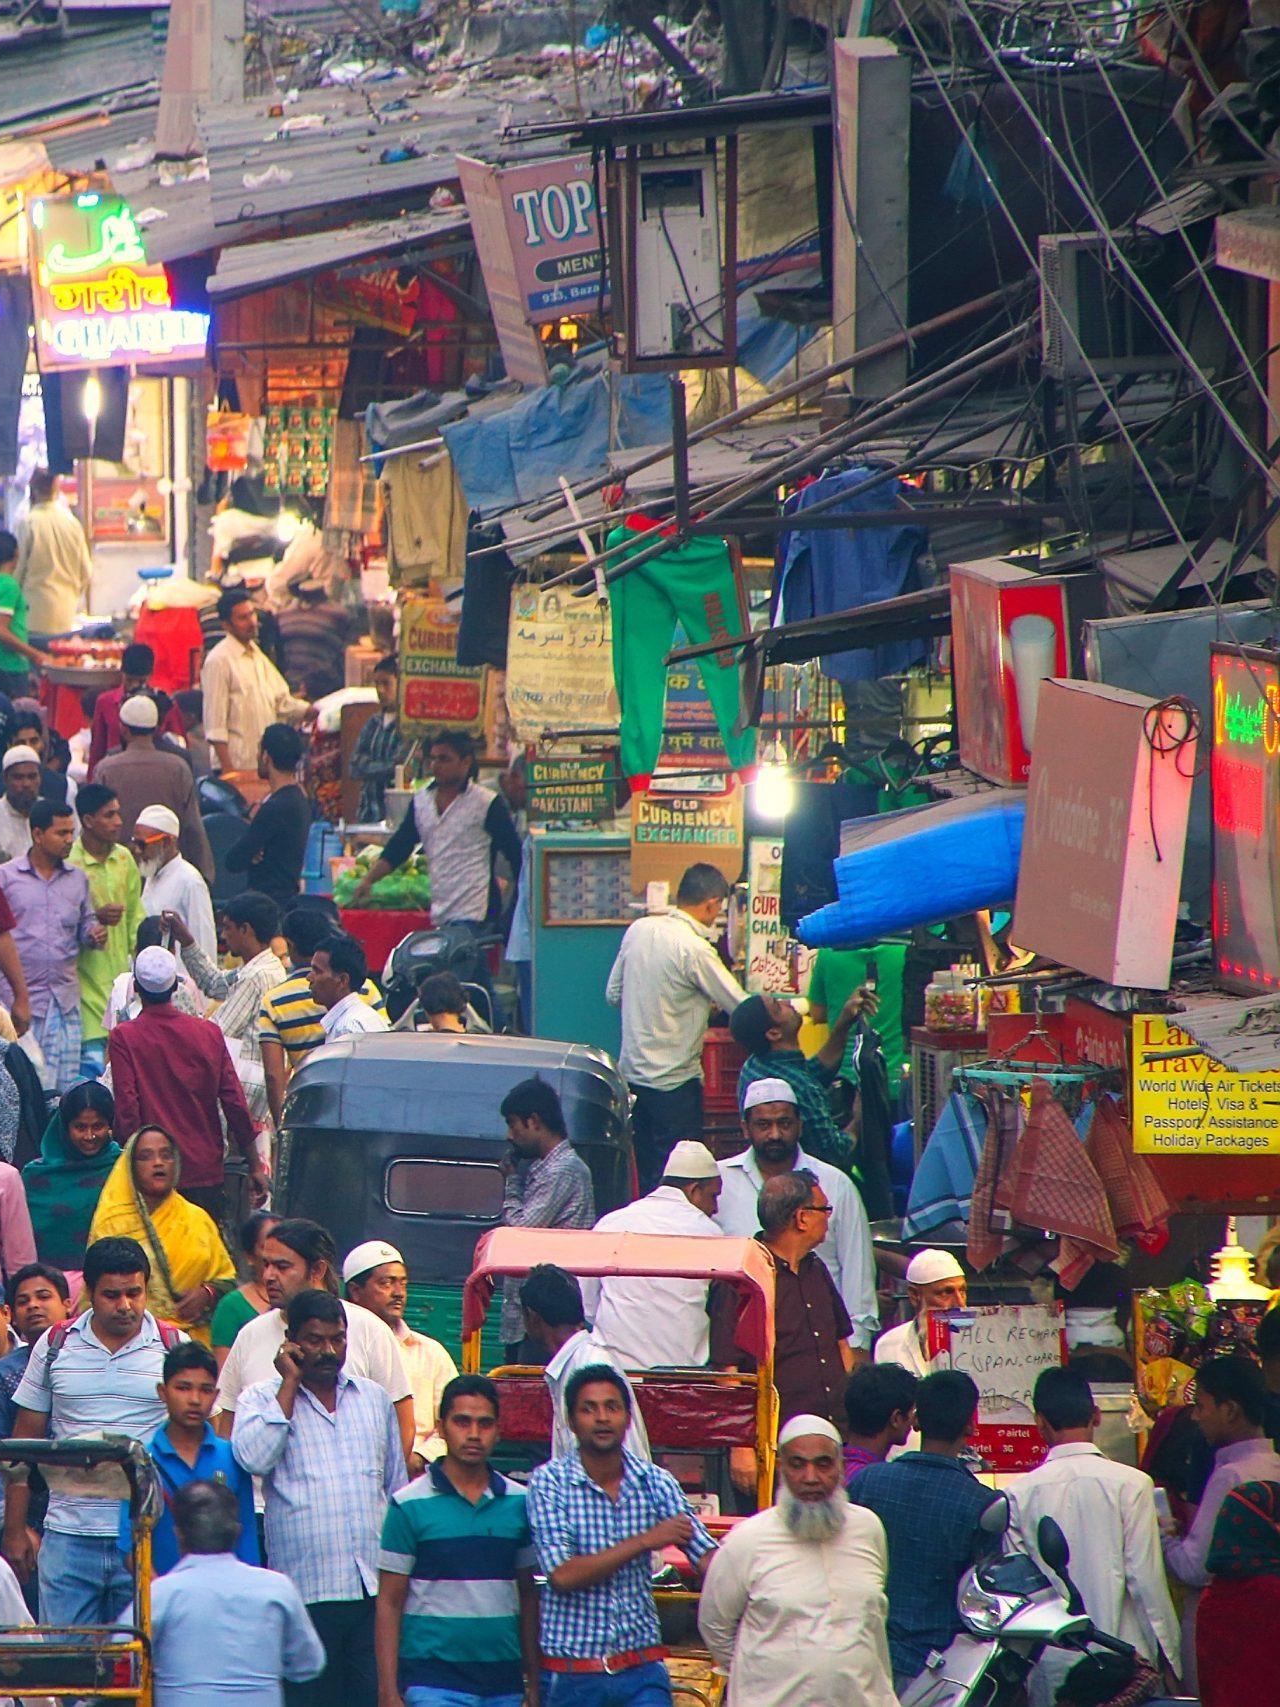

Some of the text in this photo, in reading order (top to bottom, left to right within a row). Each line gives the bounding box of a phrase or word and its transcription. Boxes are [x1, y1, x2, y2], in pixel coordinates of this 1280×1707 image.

[512, 180, 594, 246] TOP
[570, 285, 601, 298] Baza
[53, 311, 210, 357] GHAREE
[533, 763, 606, 781] CURRENCY
[672, 799, 699, 810] OLD
[638, 801, 734, 827] CURRENCY
[636, 825, 738, 845] EXCHANGER
[766, 939, 803, 957] HRE
[1139, 1080, 1176, 1092] World
[1181, 1080, 1214, 1092] Wide
[1216, 1080, 1235, 1092] Air
[1217, 1098, 1245, 1110] Visa
[1249, 1098, 1258, 1110] &
[1208, 1115, 1279, 1128] Assistance
[1153, 1133, 1269, 1149] Holiday Packages
[960, 1326, 995, 1345] ALL
[1006, 1427, 1031, 1438] airtel
